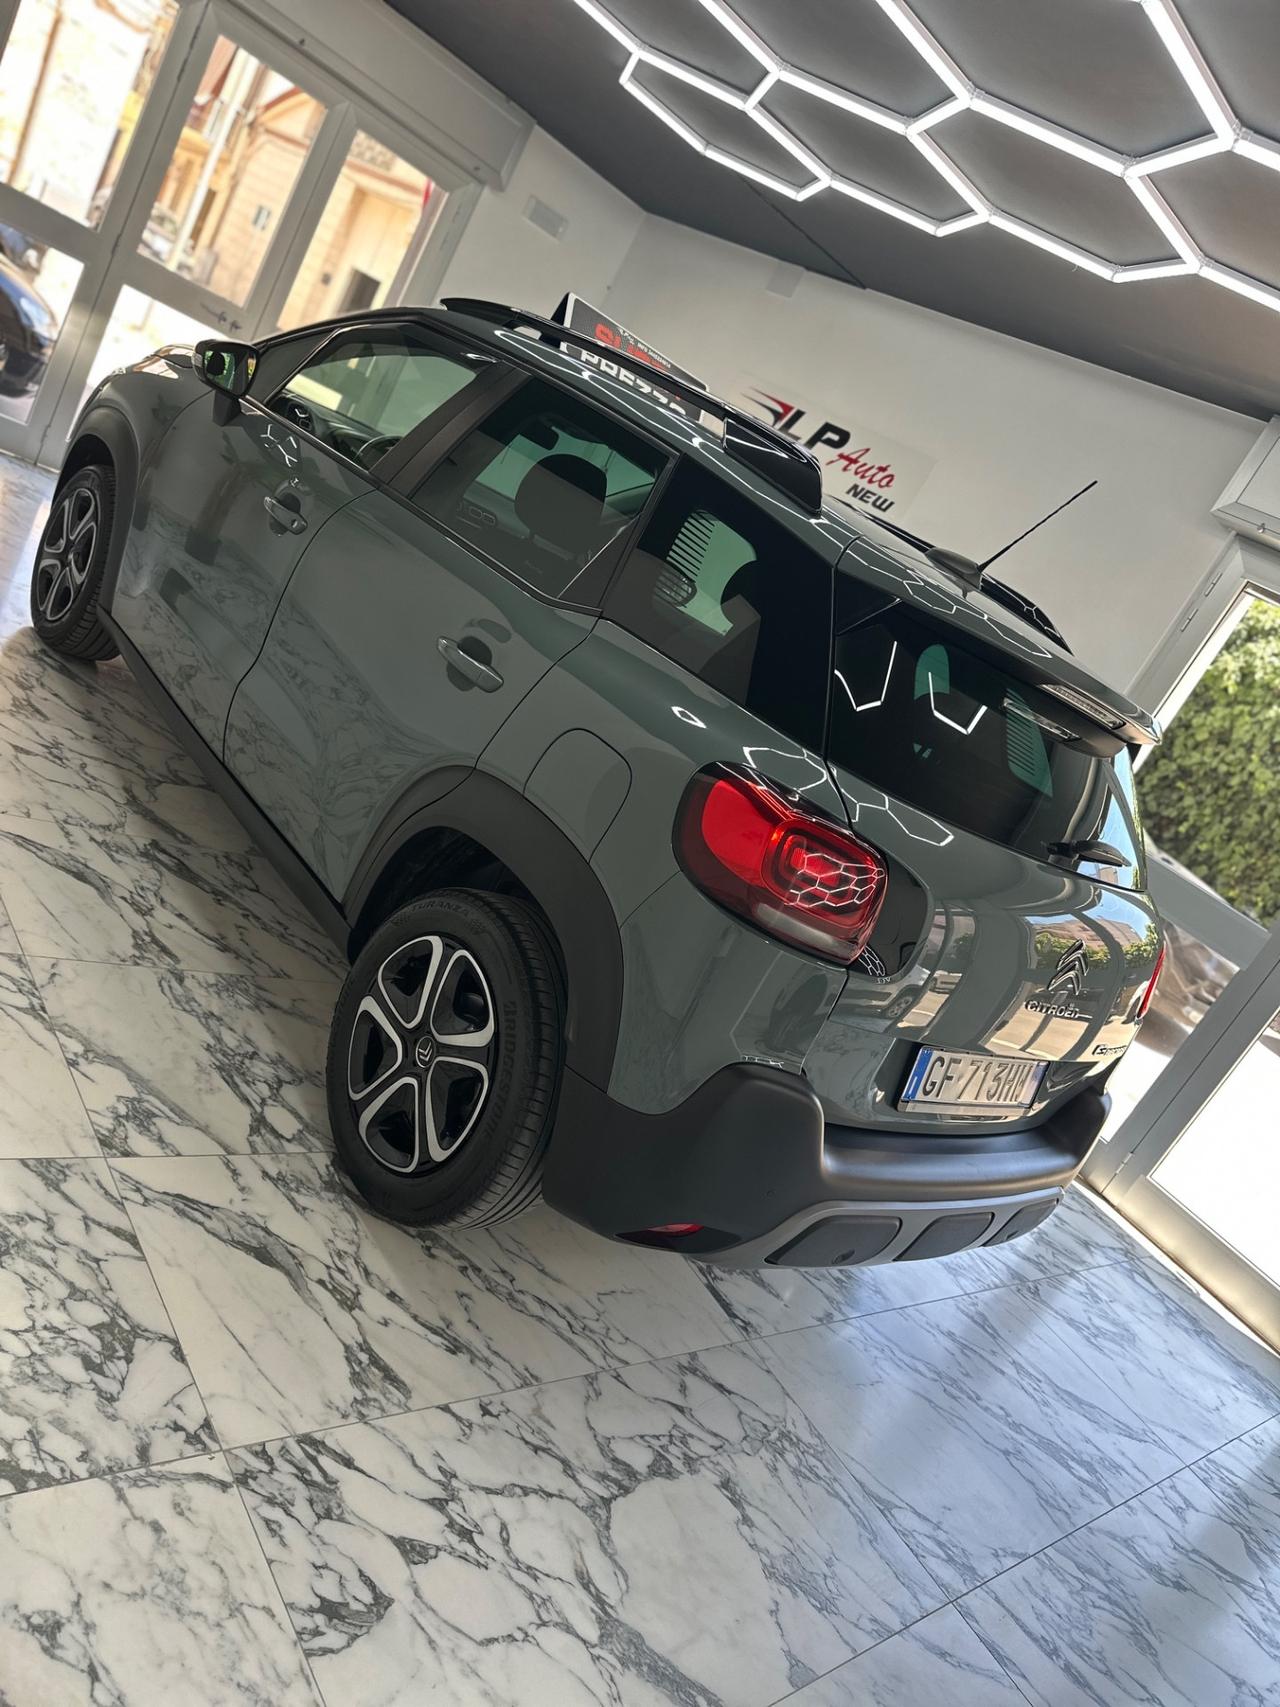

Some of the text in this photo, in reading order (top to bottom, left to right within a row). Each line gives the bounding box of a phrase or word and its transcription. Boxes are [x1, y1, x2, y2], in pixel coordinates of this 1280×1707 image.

[778, 409, 896, 489] LP Auto
[845, 483, 895, 513] NEW
[921, 1055, 962, 1099] GF
